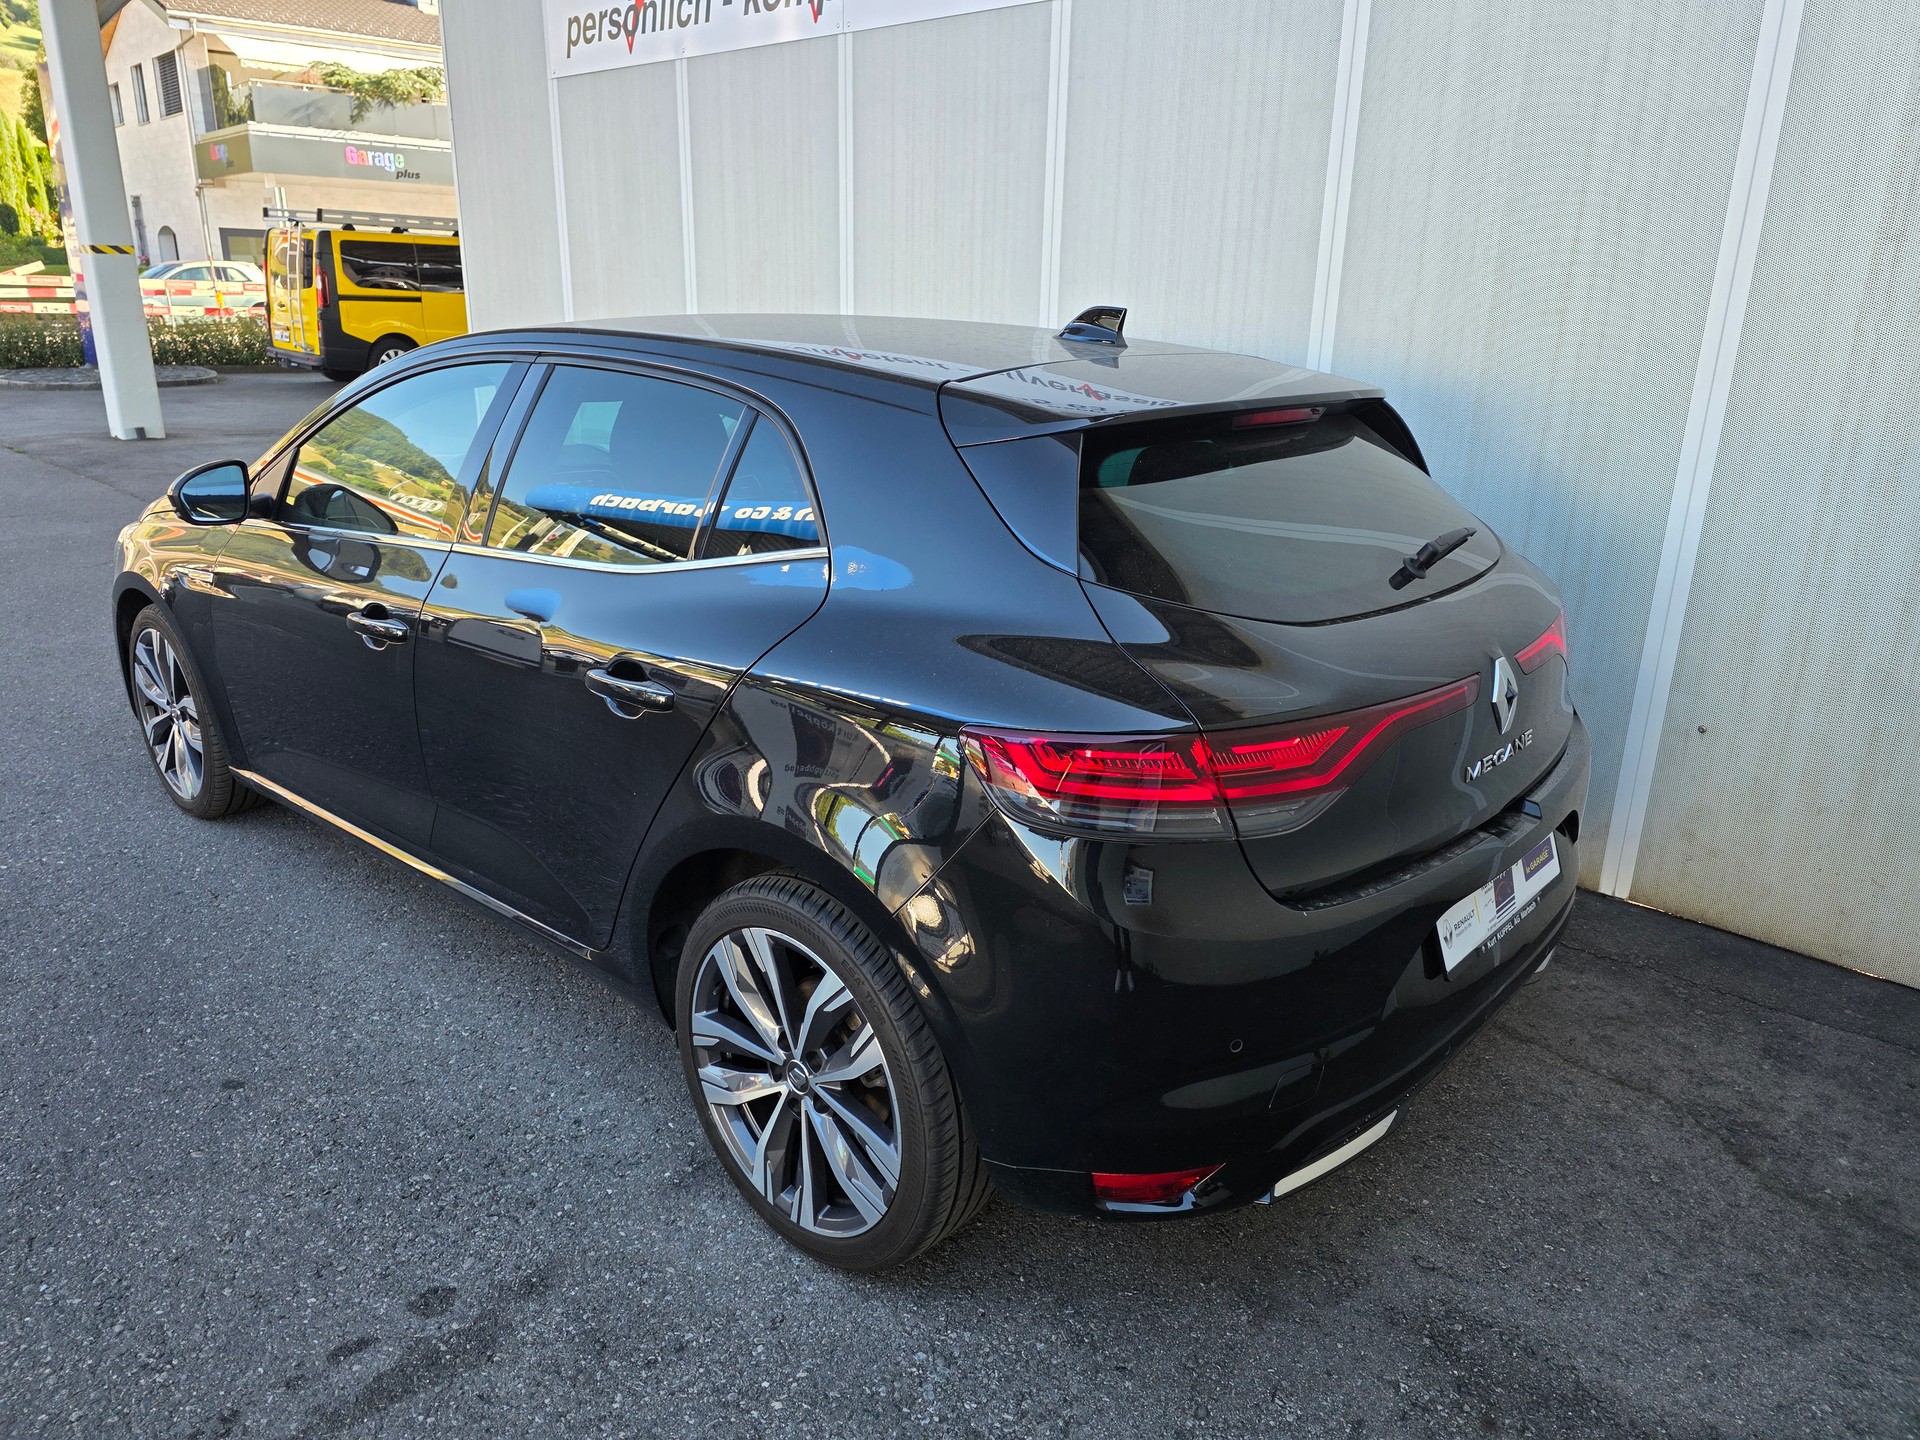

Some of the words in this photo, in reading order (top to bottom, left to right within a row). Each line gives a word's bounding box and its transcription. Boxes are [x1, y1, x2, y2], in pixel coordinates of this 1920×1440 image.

[345, 146, 405, 172] Garage
[396, 169, 421, 179] plus
[1464, 728, 1533, 783] MEGANE
[1530, 850, 1549, 871] GARAGE
[1454, 908, 1475, 931] RENAULT
